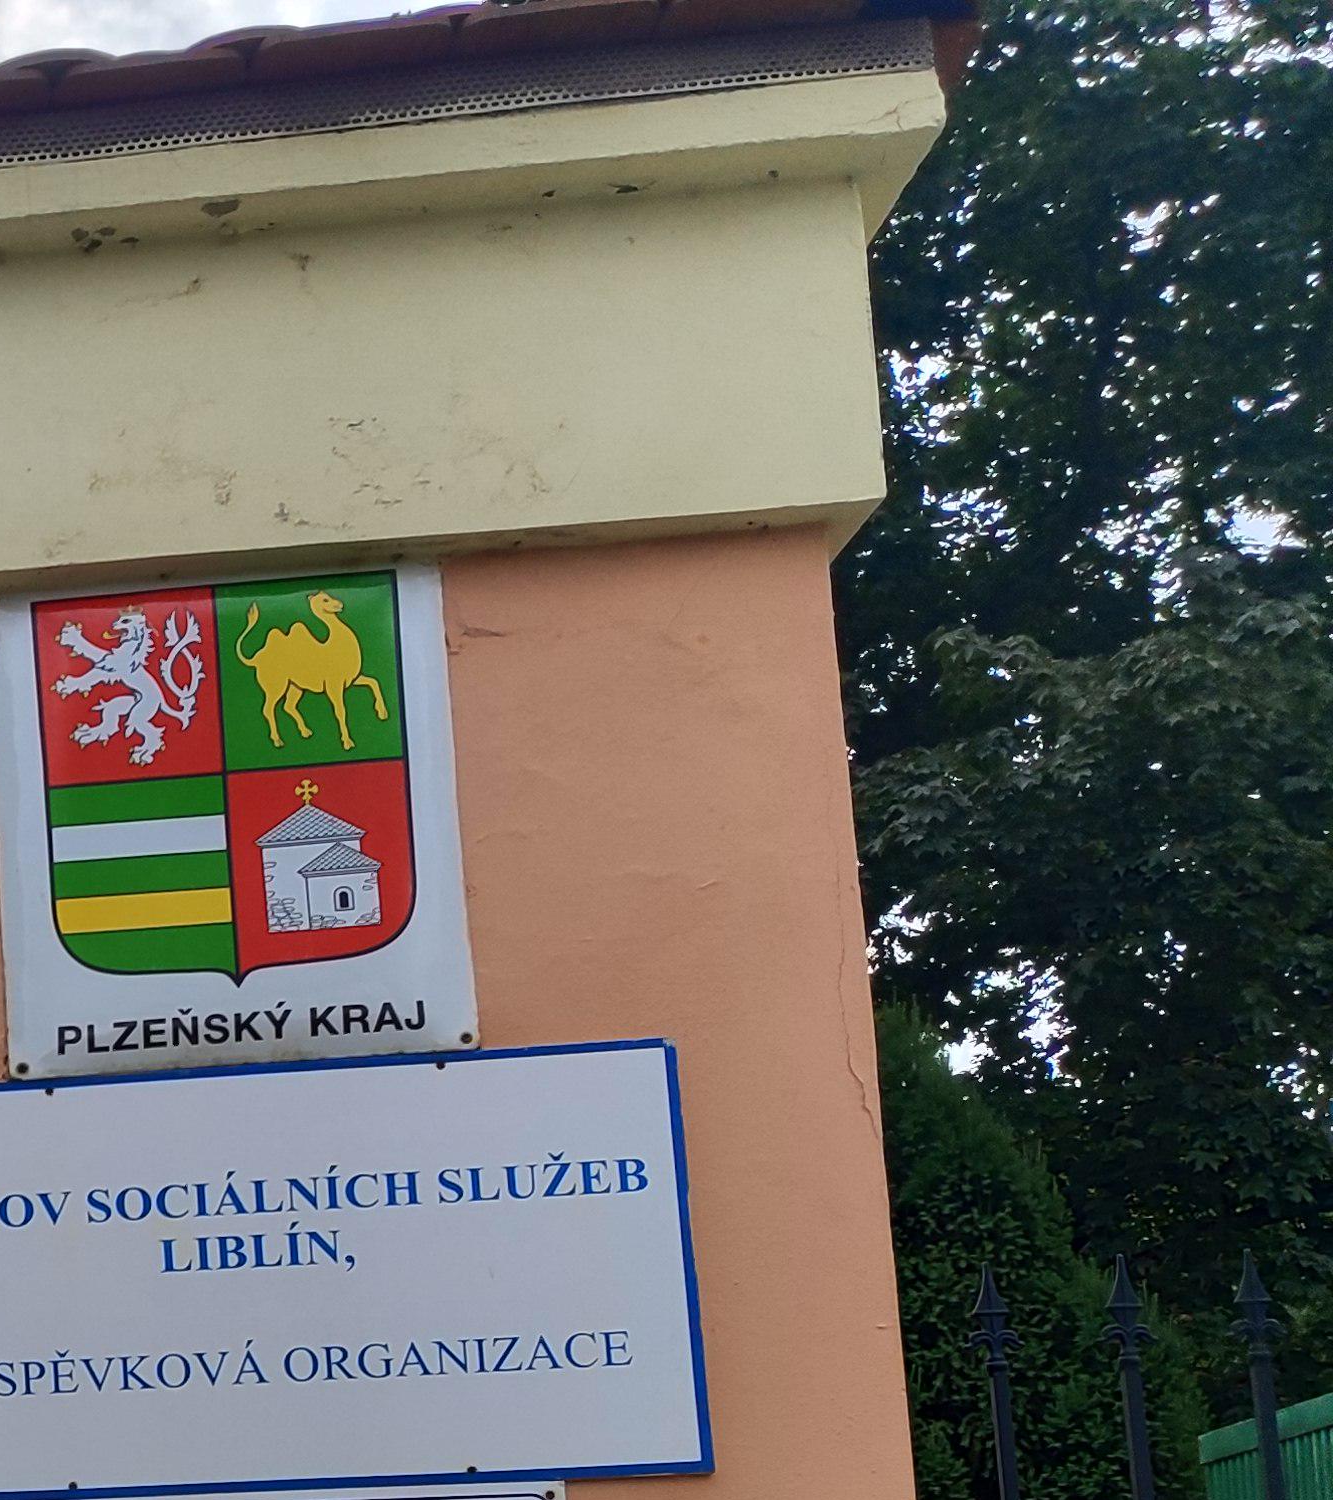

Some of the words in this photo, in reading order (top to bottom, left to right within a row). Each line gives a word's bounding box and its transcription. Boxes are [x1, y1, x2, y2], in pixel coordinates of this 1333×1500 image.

[58, 1002, 295, 1055] PLZEŇSKÝ
[310, 1001, 425, 1037] KRAJ
[87, 1165, 421, 1224] SOCIÁLNÍCH
[438, 1152, 648, 1203] SLUŽEB
[161, 1221, 356, 1273] LIBLÍN,
[284, 1331, 632, 1382] ORGANIZACE
